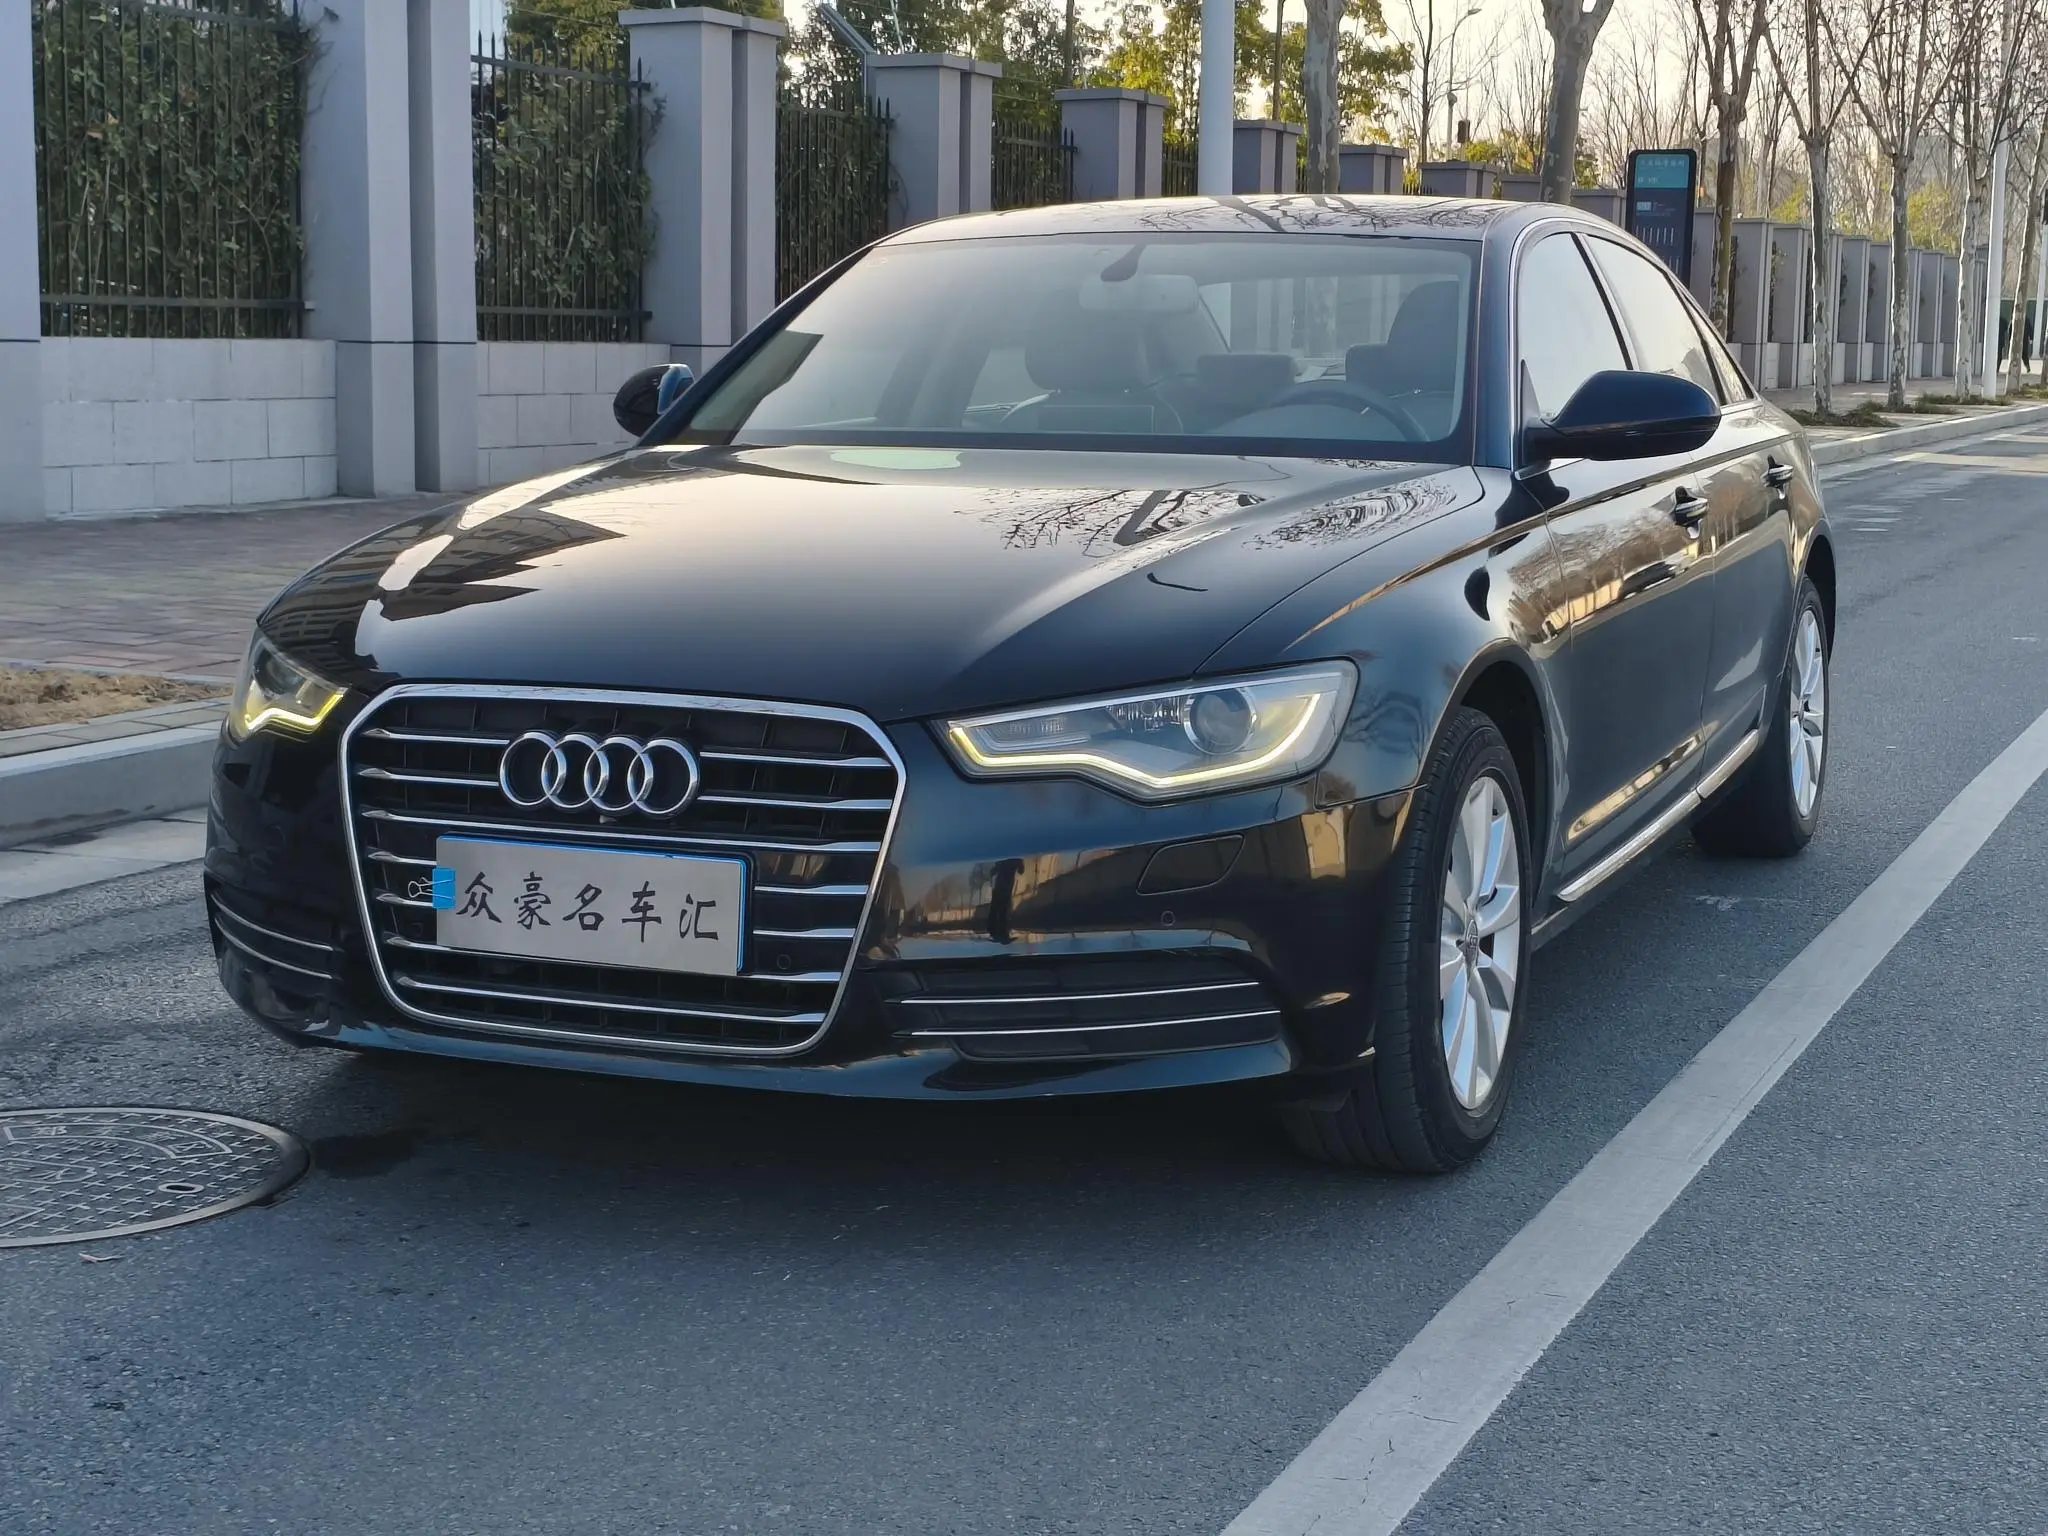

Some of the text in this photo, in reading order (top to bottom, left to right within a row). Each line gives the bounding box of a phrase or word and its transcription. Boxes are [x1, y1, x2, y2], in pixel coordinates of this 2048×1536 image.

[455, 871, 720, 943] 众豪名车汇
